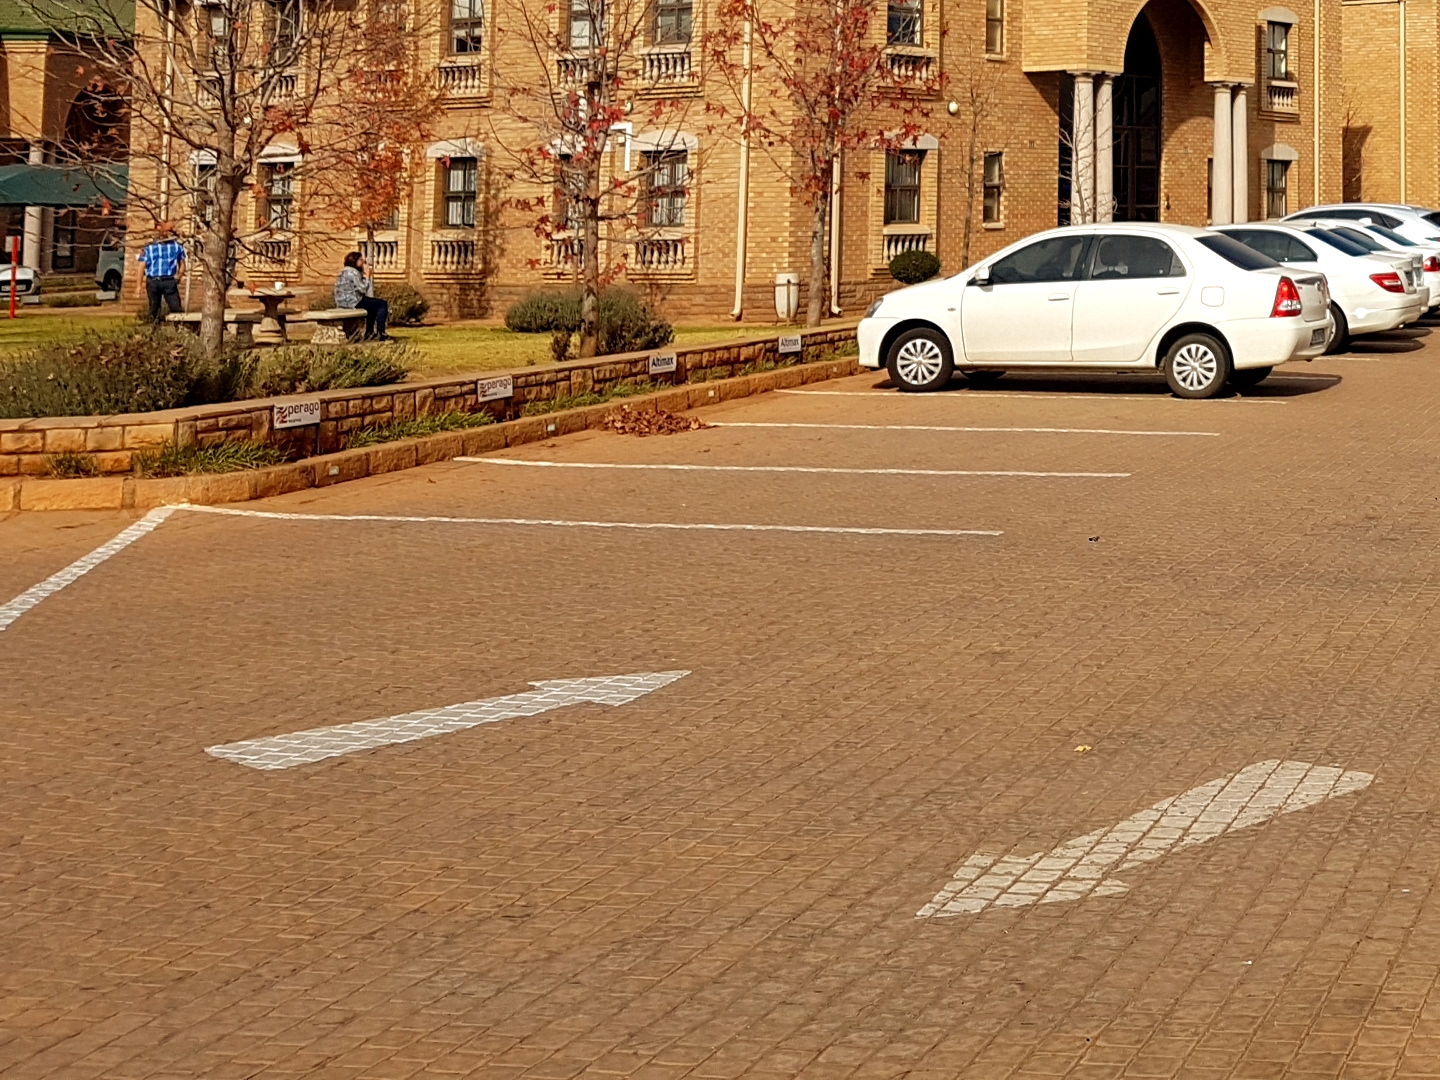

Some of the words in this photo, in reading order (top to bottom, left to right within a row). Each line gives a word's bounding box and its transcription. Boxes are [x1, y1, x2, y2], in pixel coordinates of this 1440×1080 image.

[651, 357, 674, 368] Altimax
[487, 377, 512, 392] perago
[287, 401, 320, 418] perago
